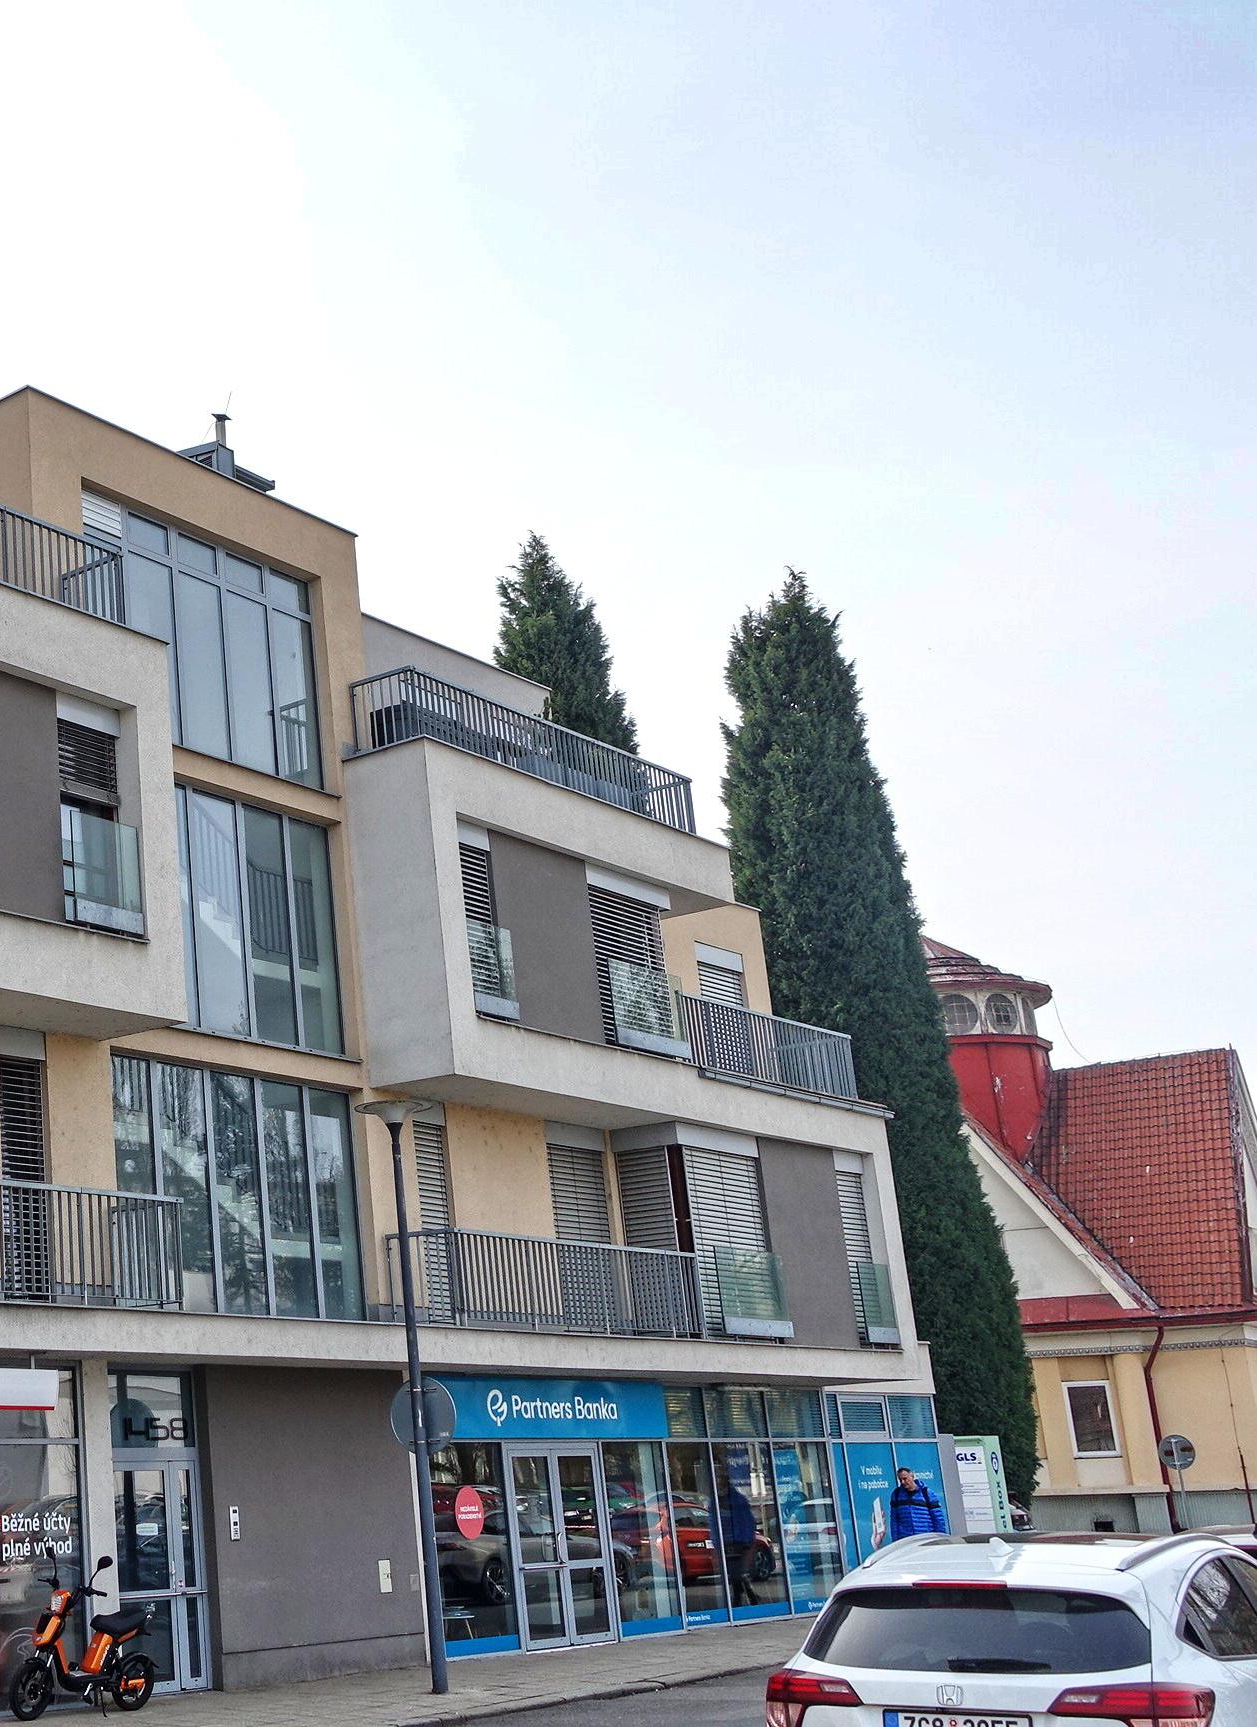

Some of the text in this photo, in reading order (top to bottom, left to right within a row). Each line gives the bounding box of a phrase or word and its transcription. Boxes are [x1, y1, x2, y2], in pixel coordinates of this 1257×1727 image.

[511, 1394, 619, 1420] Partners Banka
[955, 1452, 977, 1462] GLS
[1, 1511, 71, 1534] Běžné účty
[2, 1537, 31, 1562] plné
